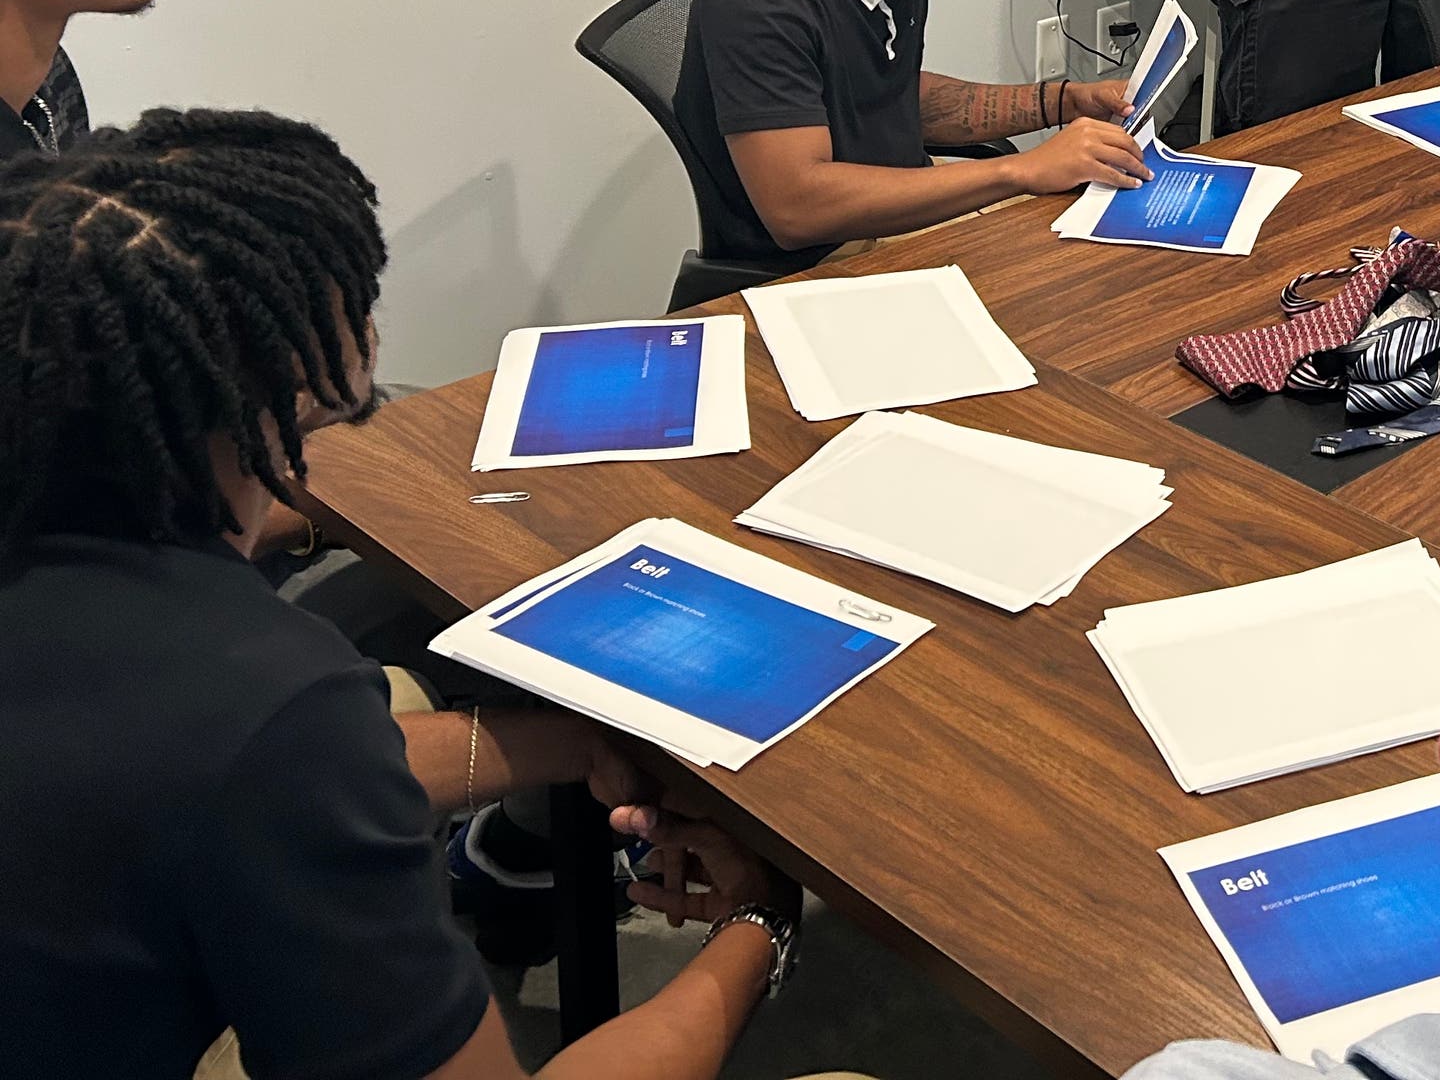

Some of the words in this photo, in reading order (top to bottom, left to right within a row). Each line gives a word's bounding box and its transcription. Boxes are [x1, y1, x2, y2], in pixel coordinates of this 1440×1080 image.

[629, 558, 671, 579] Belt
[1220, 869, 1269, 896] Belt
[1320, 879, 1357, 895] matching
[1356, 874, 1378, 885] shoes
